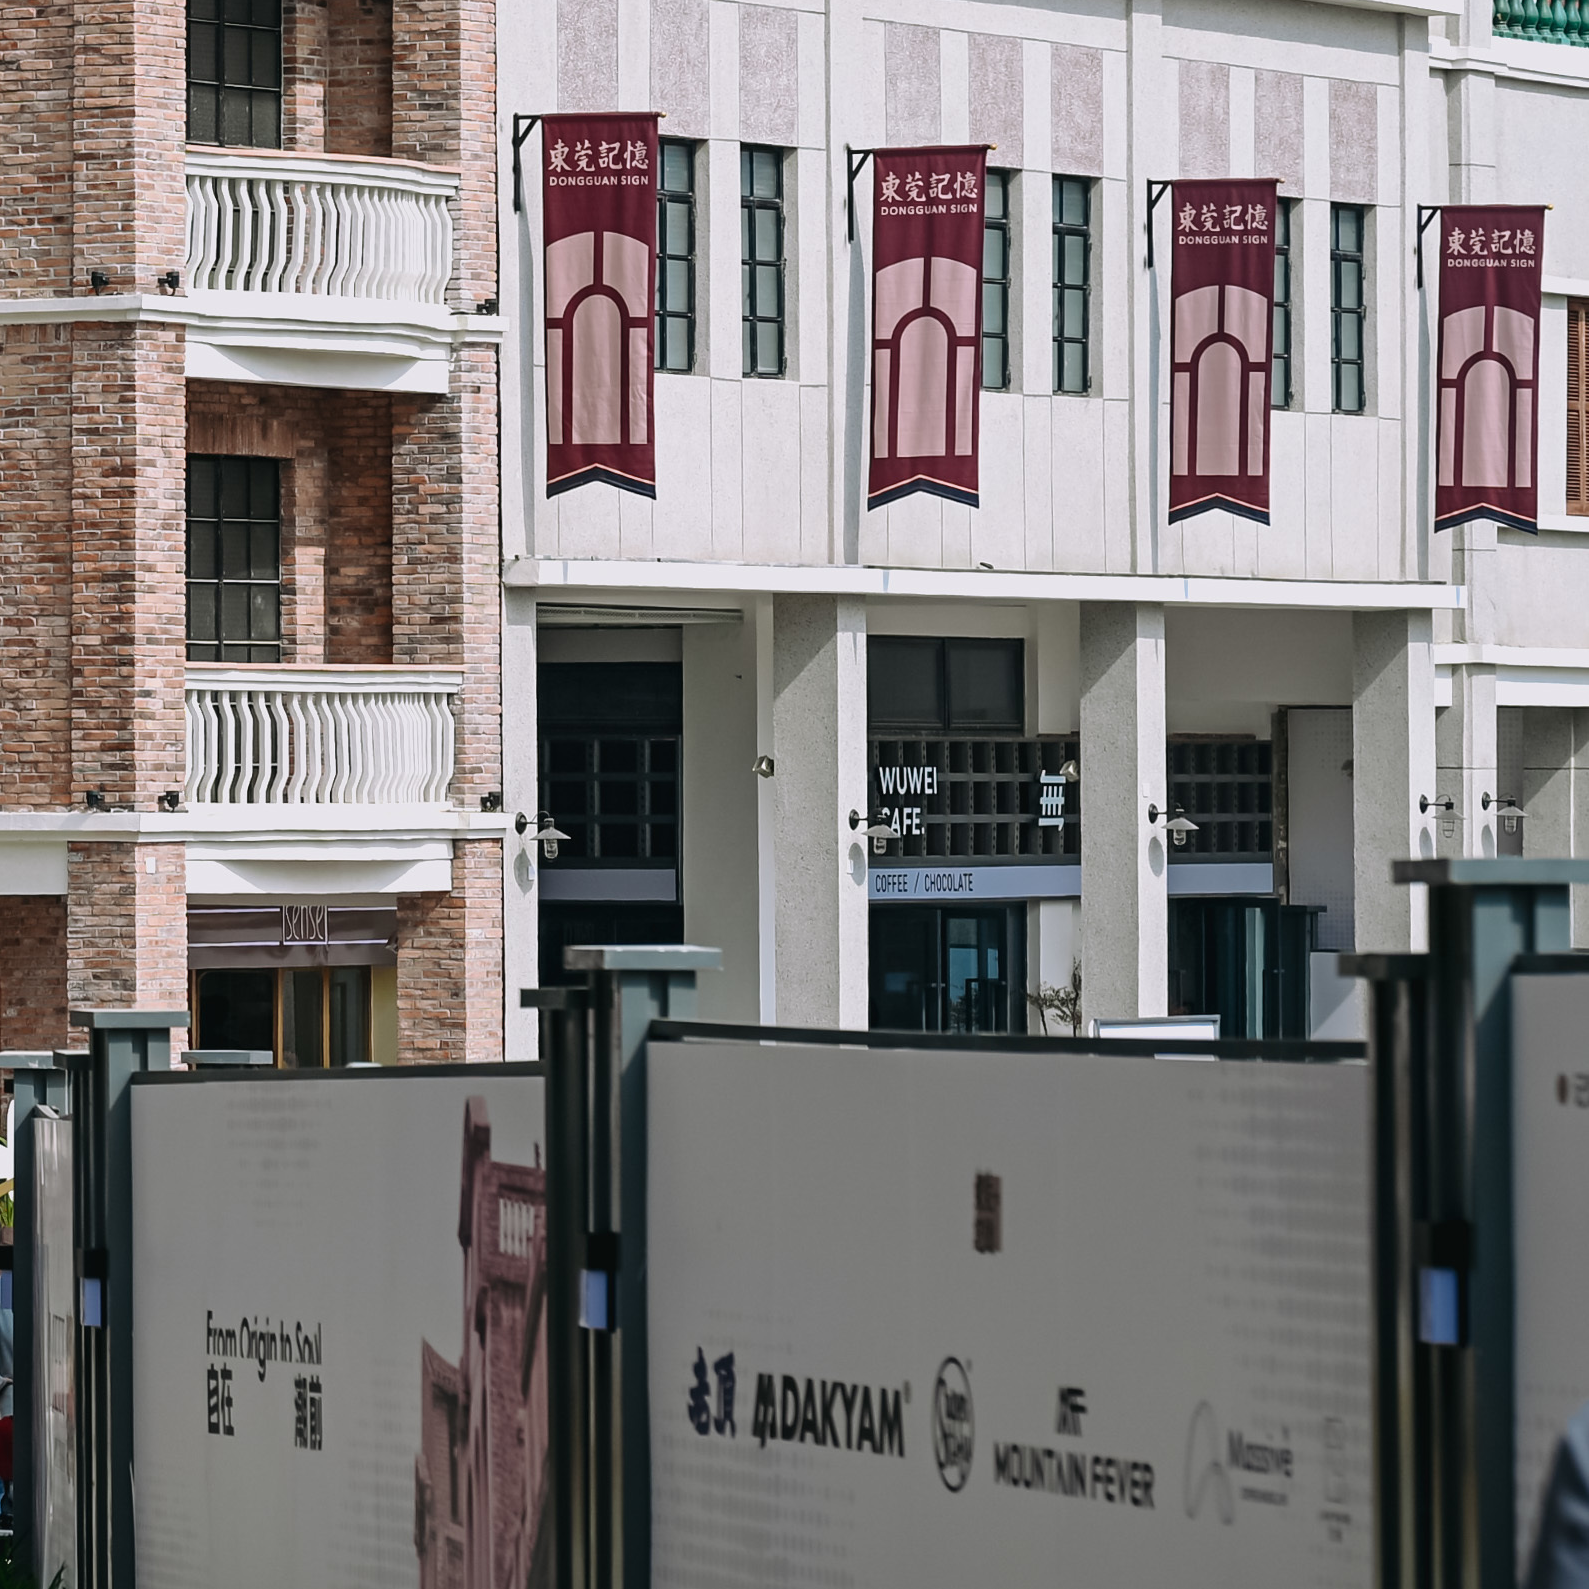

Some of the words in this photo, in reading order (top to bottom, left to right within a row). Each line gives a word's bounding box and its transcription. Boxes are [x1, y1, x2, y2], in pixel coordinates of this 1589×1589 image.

[548, 139, 649, 172] 東莞記憶
[549, 176, 618, 186] DONGGUAN
[621, 175, 649, 185] SIGN
[880, 171, 978, 203] 東莞記憶
[881, 205, 947, 215] DONGGUAN
[950, 203, 978, 214] SIGN
[1177, 202, 1269, 232] 東莞記憶
[1179, 236, 1239, 245] DONGGUAN
[1243, 235, 1268, 244] SIGN
[1447, 227, 1536, 255] 東莞記憶
[1448, 259, 1507, 267] DONGGUAN
[1511, 259, 1535, 267] SIGN
[879, 766, 937, 795] WUWEI
[875, 873, 908, 893] COFFEE
[924, 873, 974, 893] CHOCOLATE
[285, 905, 324, 940] sense
[207, 1310, 237, 1357] From
[240, 1316, 277, 1382] Origin
[280, 1320, 292, 1363] to
[296, 1321, 322, 1365] Soul
[207, 1363, 235, 1436] 自在
[994, 1442, 1087, 1498] MOUNTAIN
[1090, 1455, 1155, 1509] FEVER
